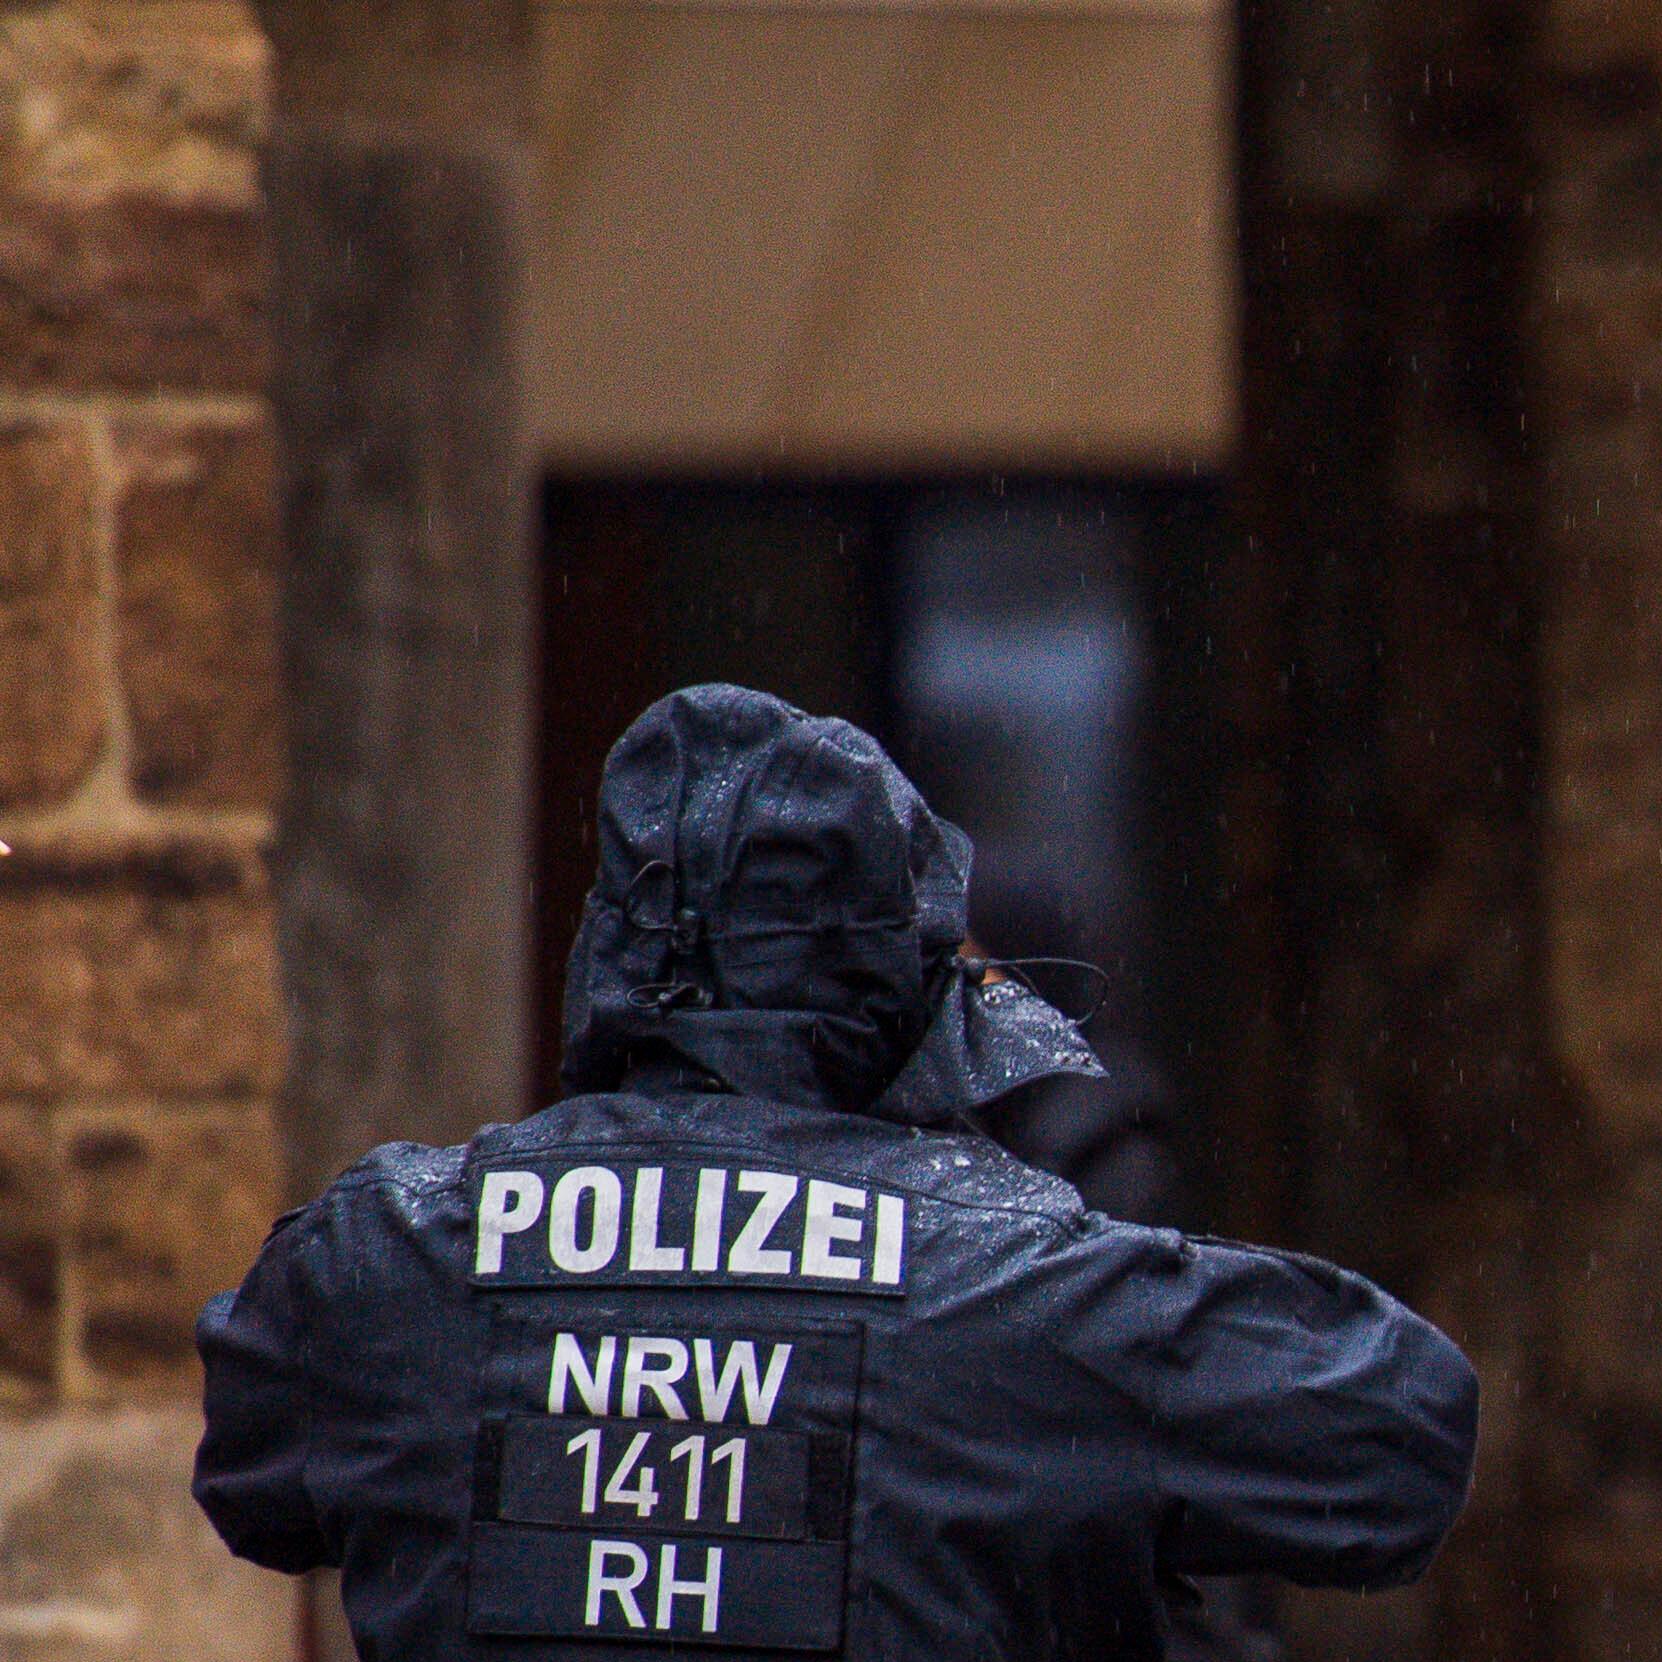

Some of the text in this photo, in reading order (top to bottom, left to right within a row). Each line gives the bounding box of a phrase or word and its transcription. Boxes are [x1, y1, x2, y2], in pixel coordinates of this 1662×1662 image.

[475, 1166, 905, 1286] POLIZEI
[547, 1333, 793, 1425] NRW
[566, 1428, 747, 1524] 1411
[584, 1539, 723, 1633] RH
